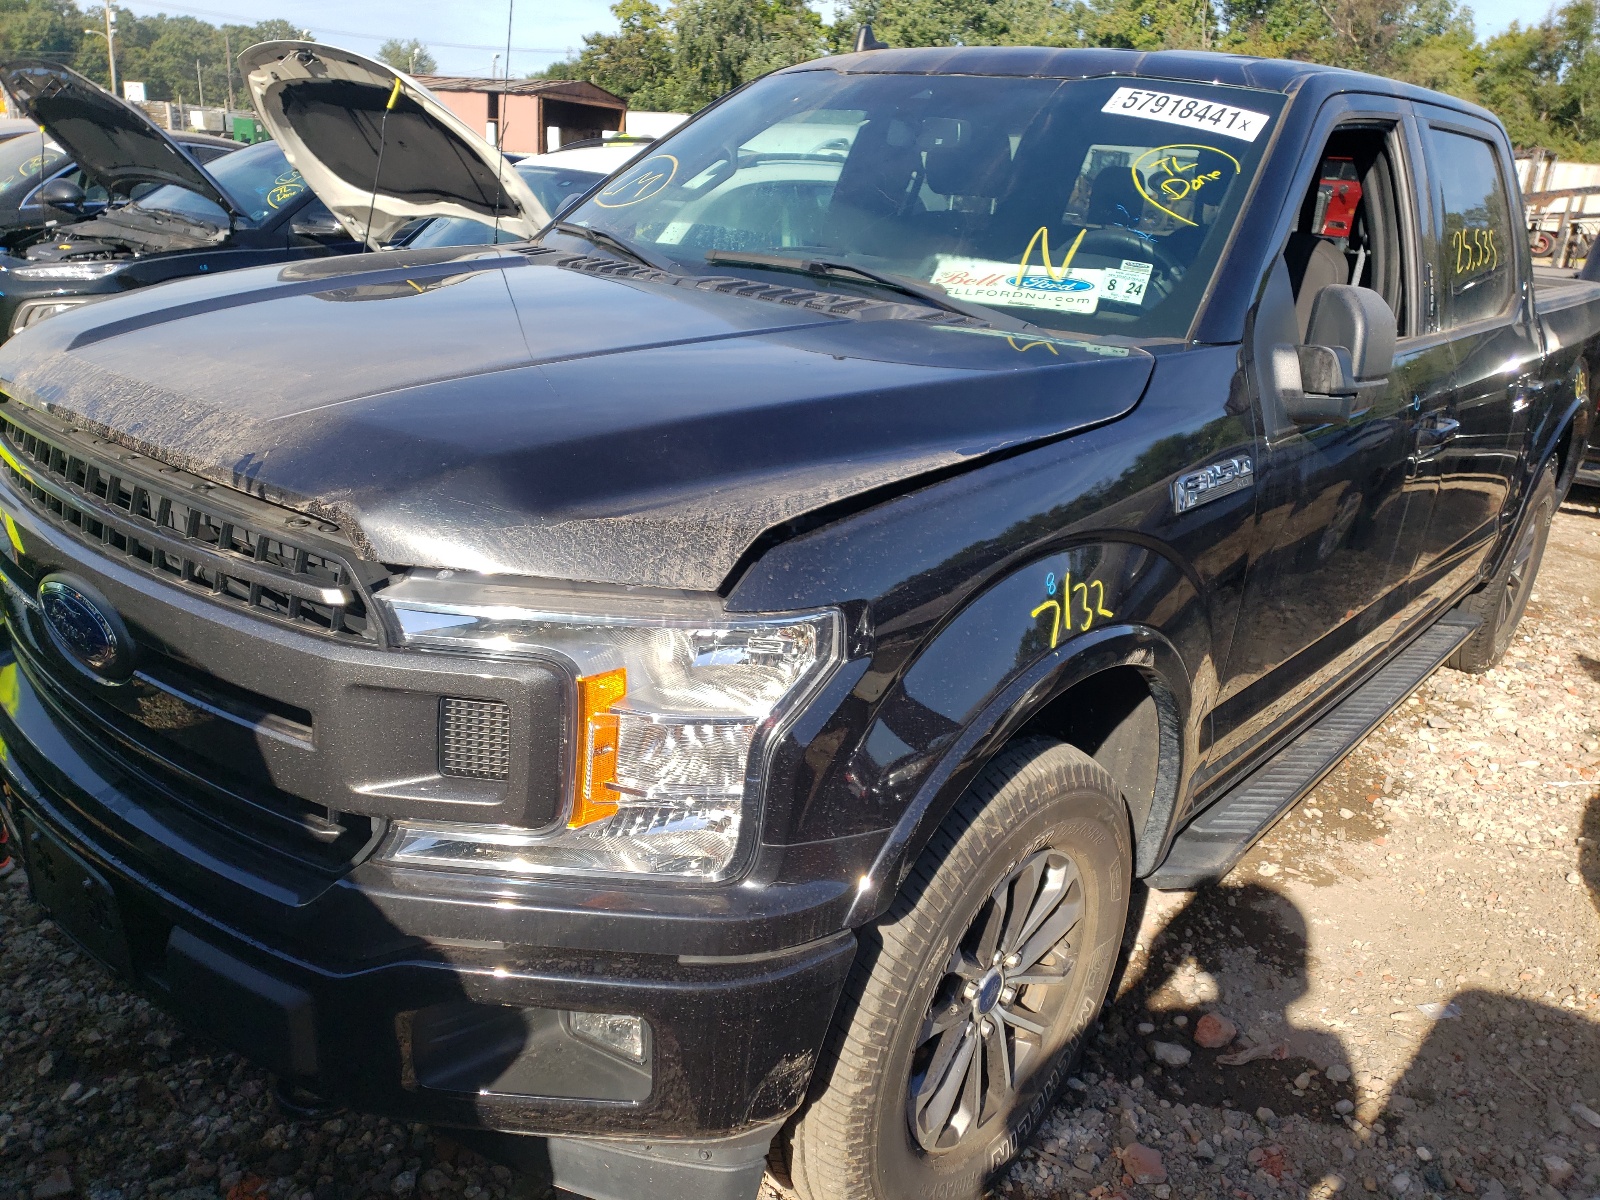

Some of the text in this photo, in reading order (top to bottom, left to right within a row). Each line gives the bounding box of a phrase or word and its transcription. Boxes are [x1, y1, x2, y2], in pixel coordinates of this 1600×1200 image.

[1160, 170, 1222, 200] Done
[936, 271, 1079, 292] Bell Ford
[1107, 278, 1117, 291] 8
[1125, 281, 1143, 296] 24
[944, 287, 1090, 304] ELLFORDNJ.com
[990, 998, 1096, 1173] MICHELIN
